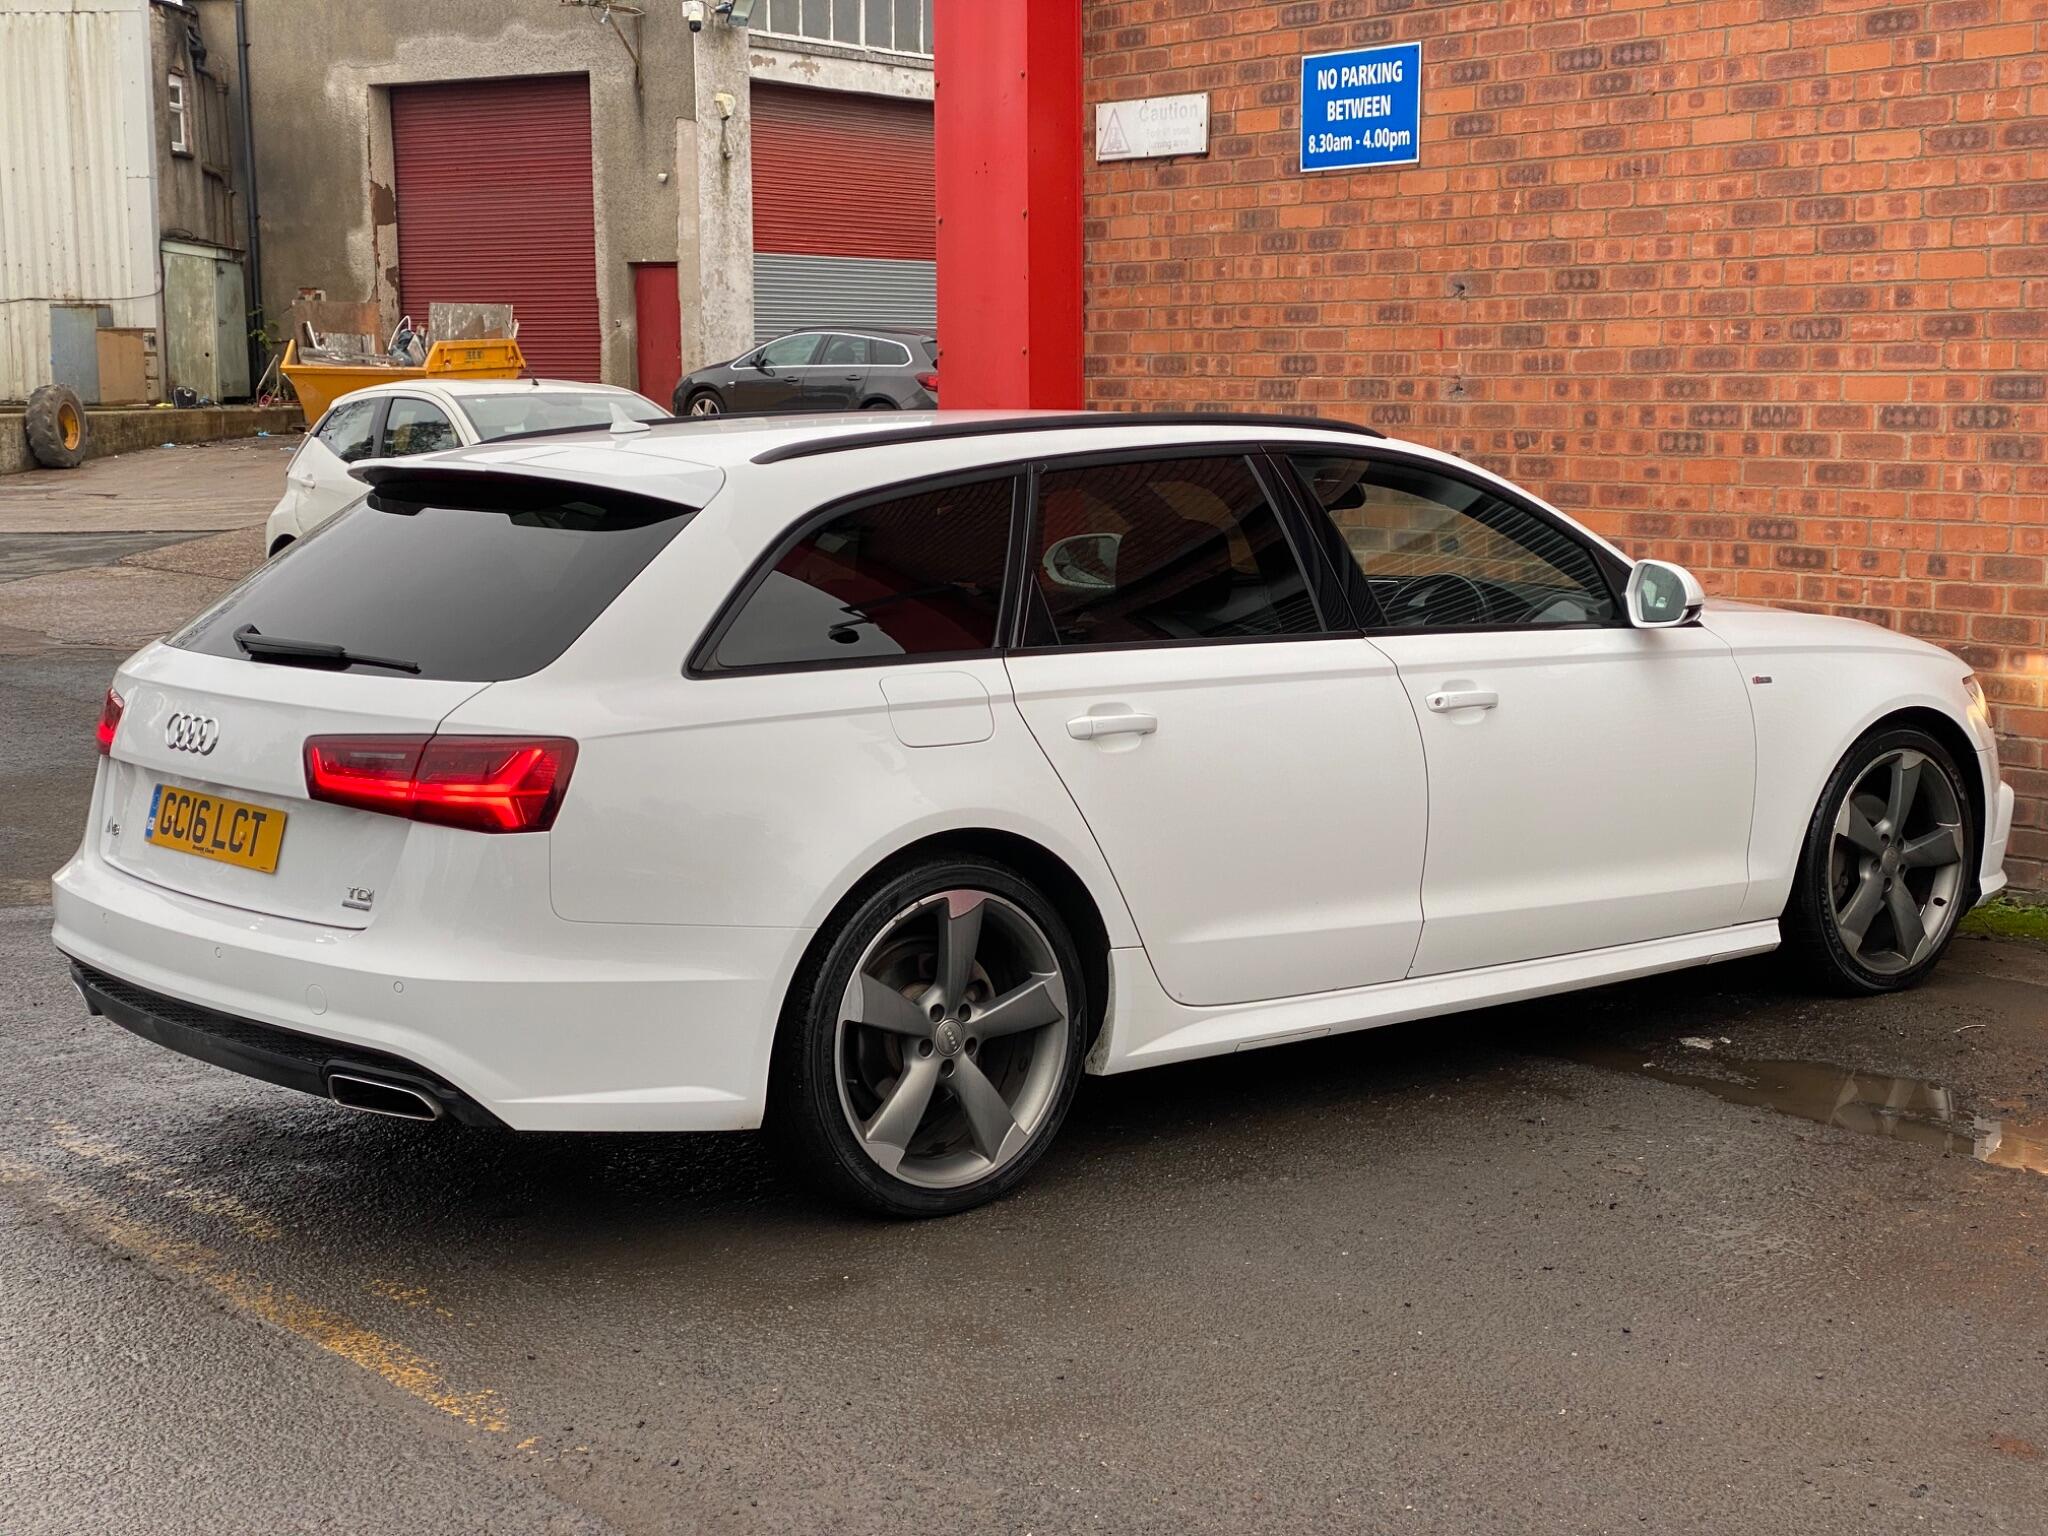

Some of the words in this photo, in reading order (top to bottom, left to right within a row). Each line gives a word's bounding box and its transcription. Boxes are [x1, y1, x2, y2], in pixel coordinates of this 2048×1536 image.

[1317, 68, 1338, 91] NO
[1341, 60, 1403, 88] PARKING
[1138, 102, 1199, 122] Caution
[1327, 95, 1392, 121] BETWEEN
[1308, 132, 1353, 154] 8.30am
[1362, 127, 1411, 152] 4.00pm
[160, 792, 211, 844] GC16
[211, 803, 267, 857] LCT
[346, 887, 375, 903] TDI
